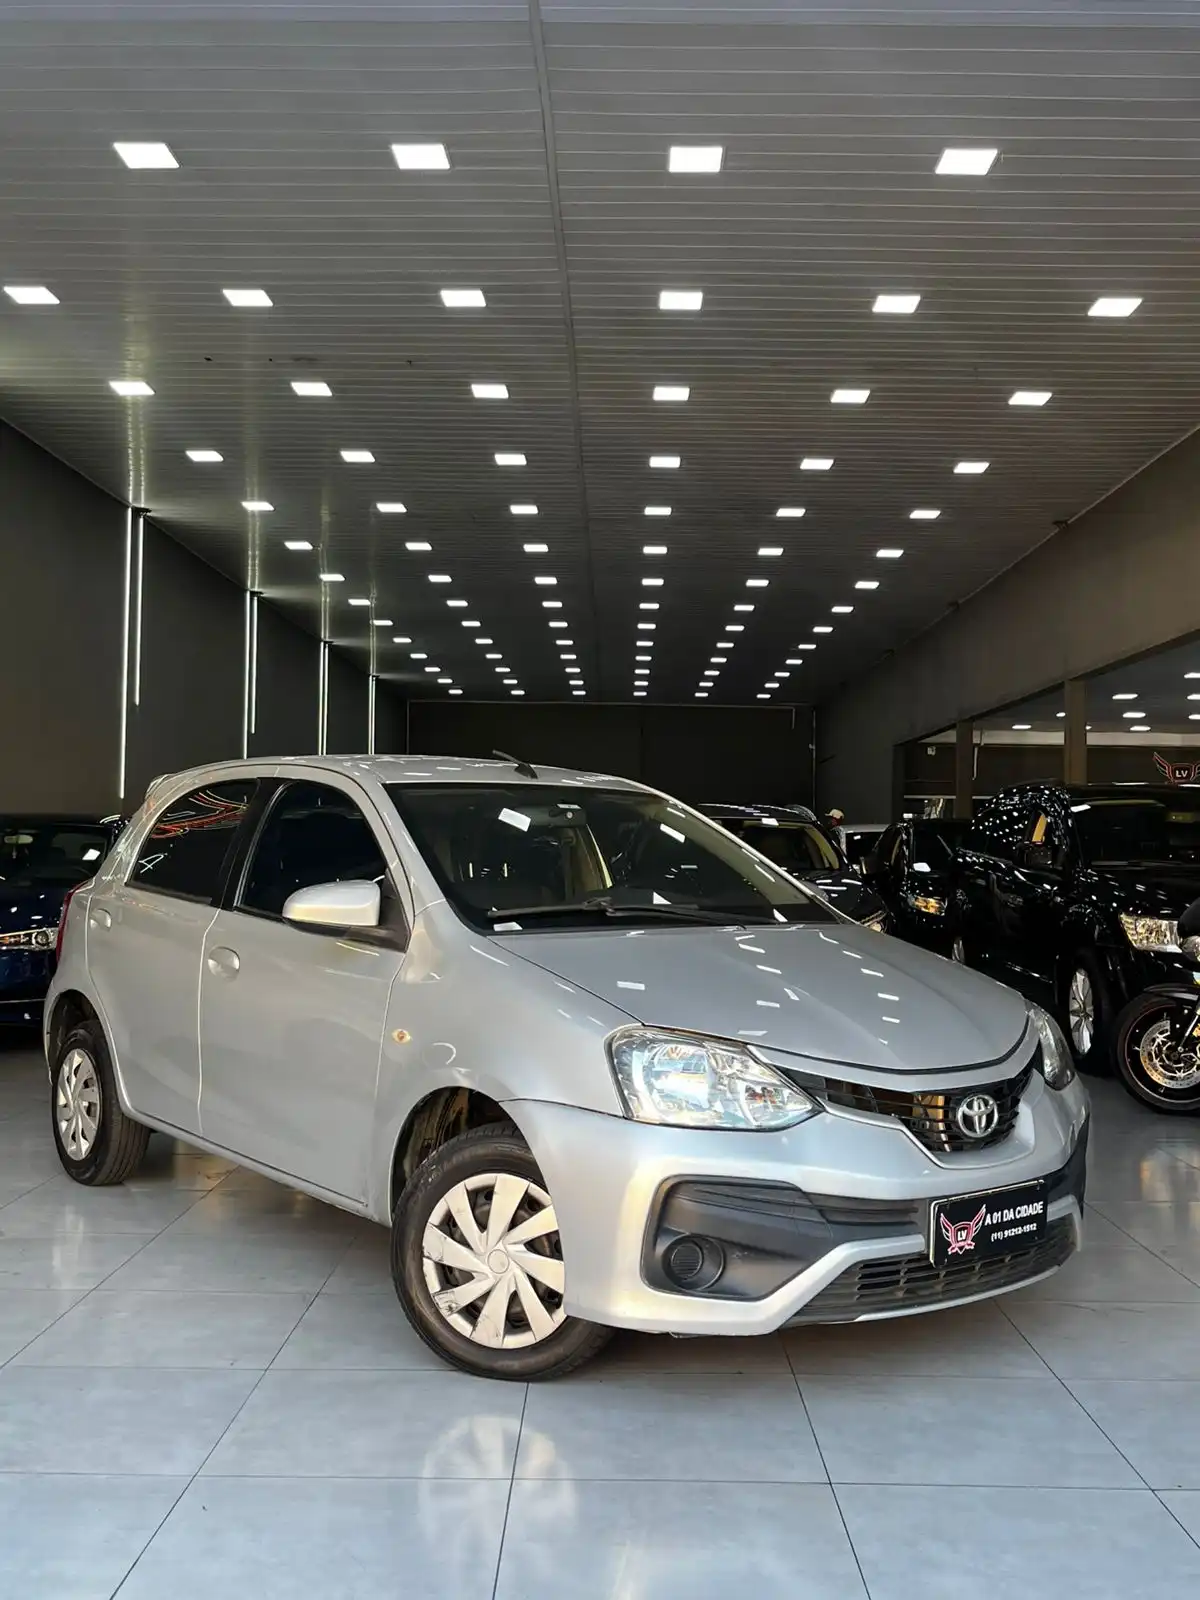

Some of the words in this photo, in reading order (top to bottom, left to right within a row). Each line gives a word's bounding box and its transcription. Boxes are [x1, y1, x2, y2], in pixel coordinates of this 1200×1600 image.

[984, 1213, 991, 1226] A
[992, 1211, 1002, 1223] 01
[1003, 1209, 1015, 1222] DA
[1015, 1201, 1044, 1219] CIDADE
[957, 1230, 968, 1241] LV
[991, 1231, 1003, 1242] (11)
